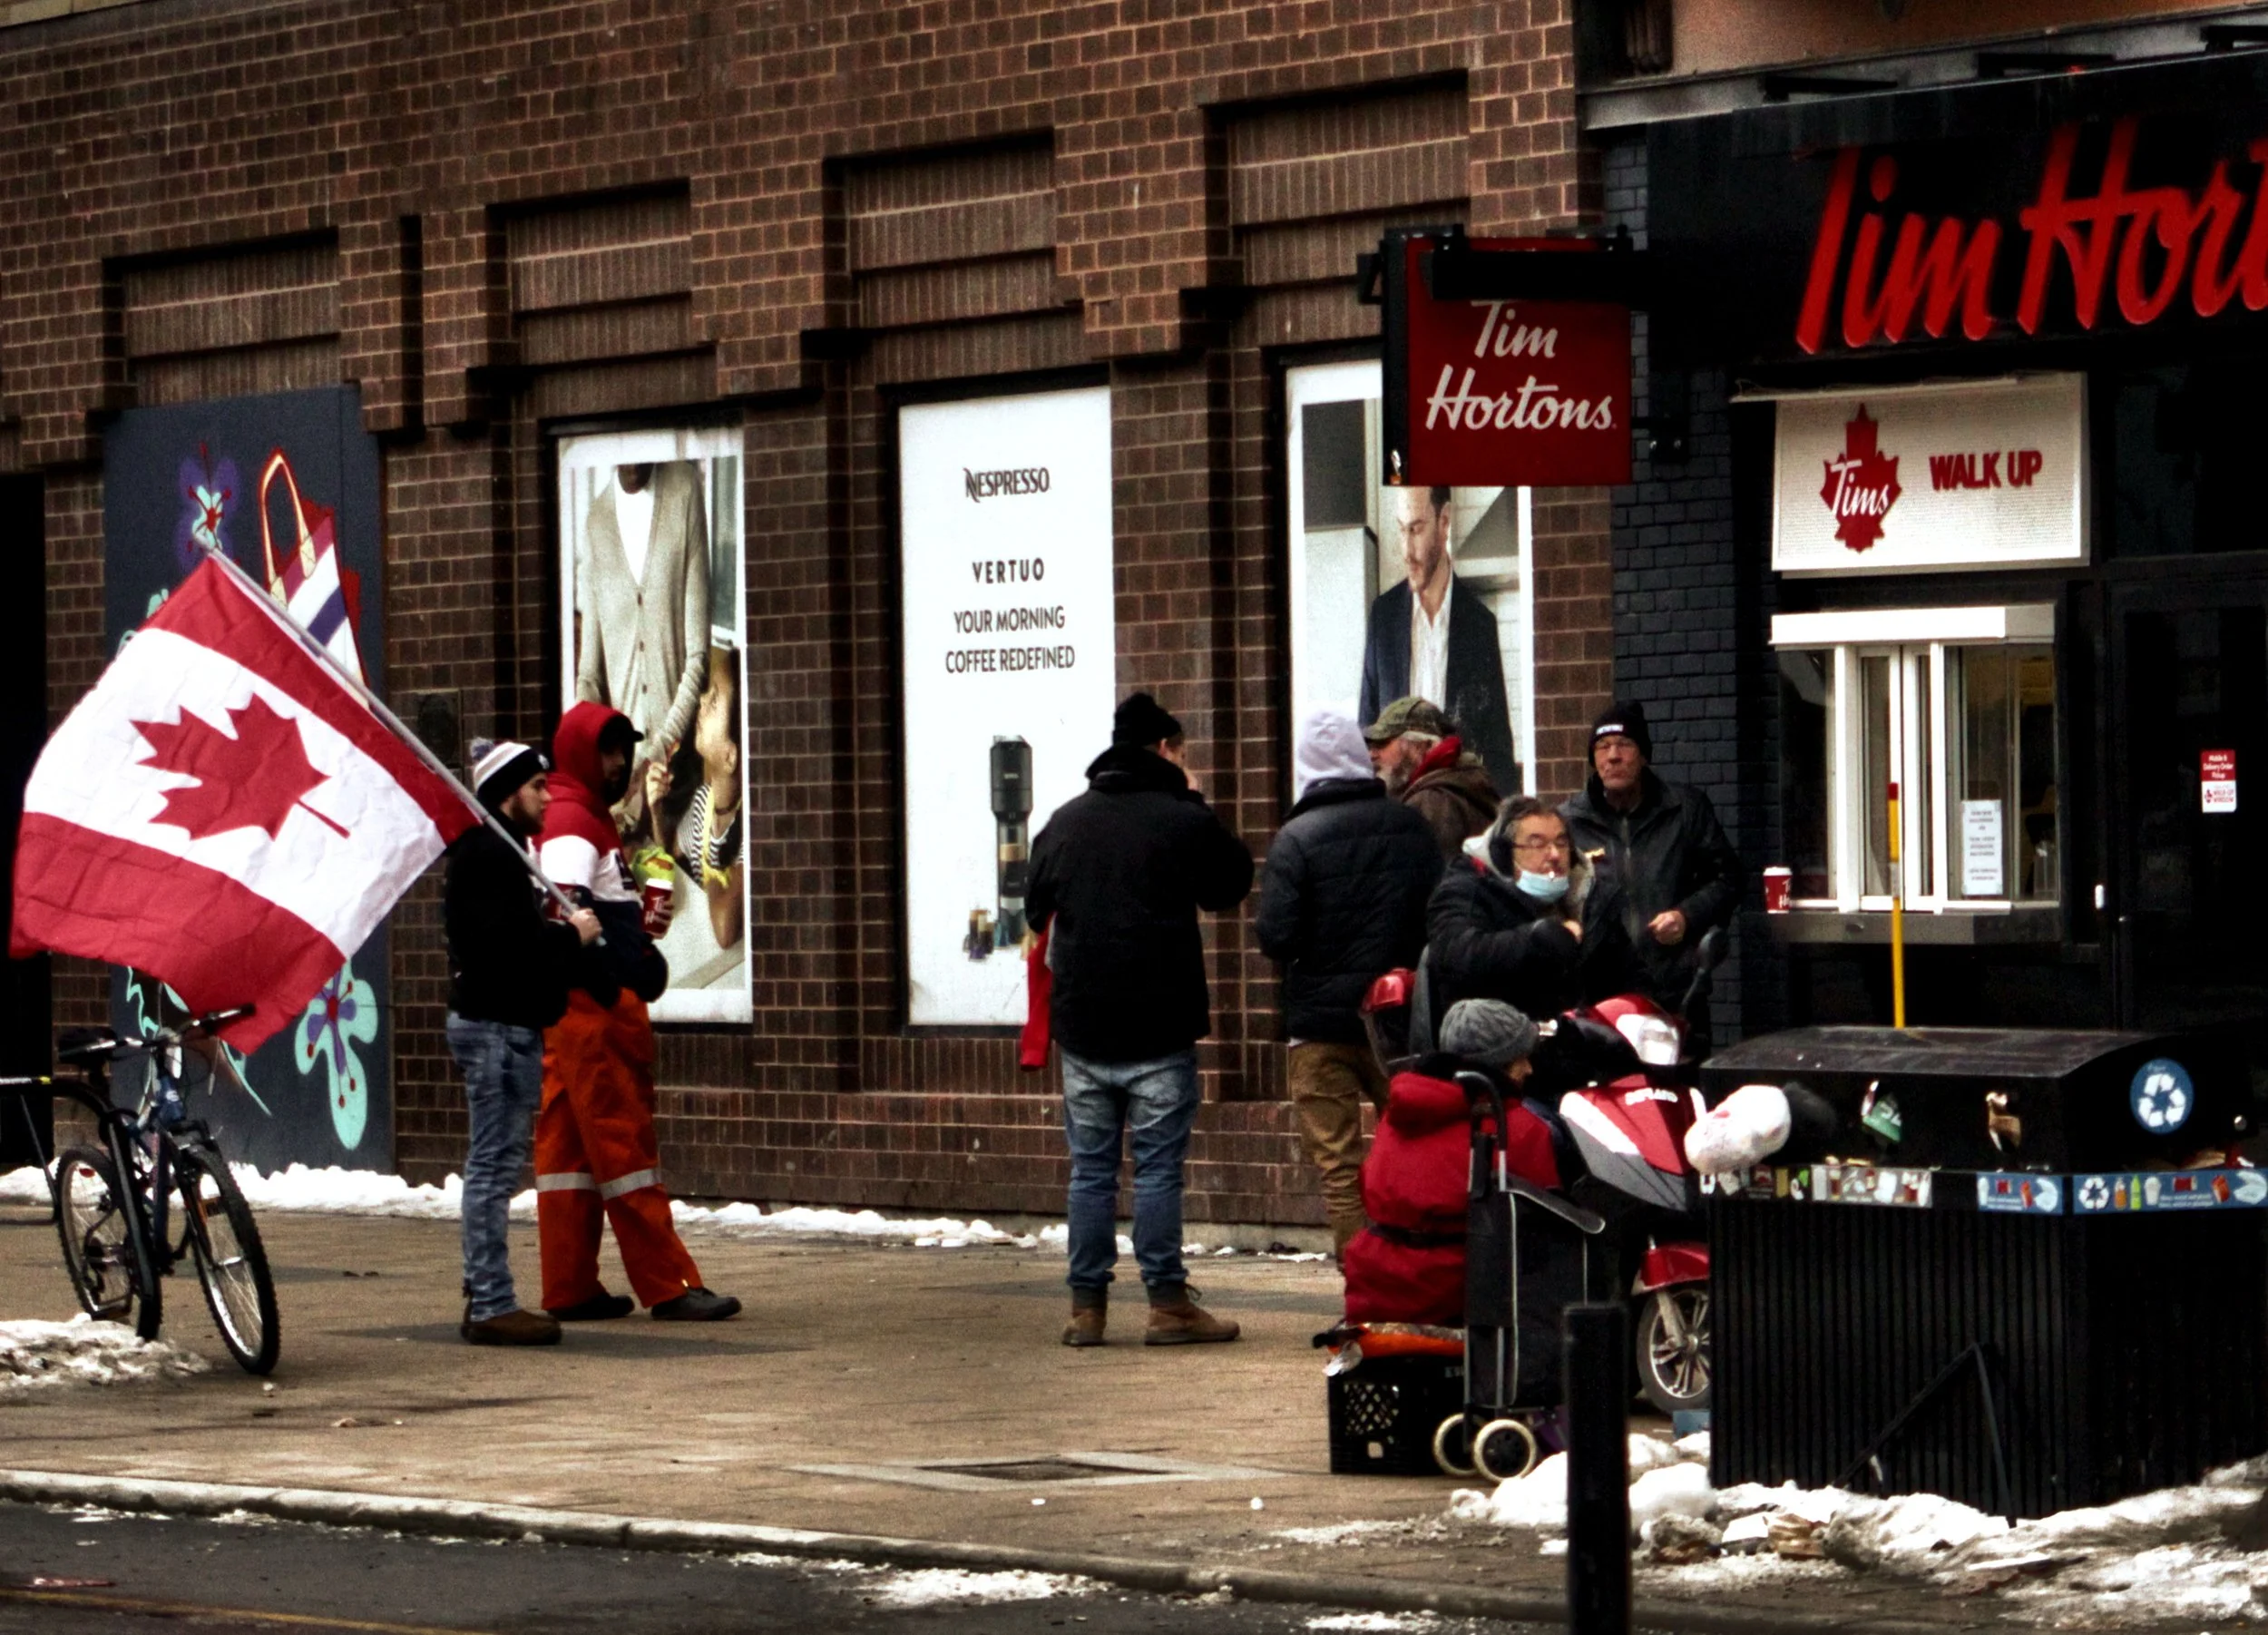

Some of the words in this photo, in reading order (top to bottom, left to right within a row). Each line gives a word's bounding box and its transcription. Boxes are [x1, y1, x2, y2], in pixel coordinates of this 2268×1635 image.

[1793, 143, 2002, 355] Tim
[1471, 299, 1559, 358] Tim
[1424, 364, 1613, 431] Hortons
[1831, 458, 1890, 516] Tims
[1930, 450, 2001, 491] WALK
[2008, 449, 2043, 488] UP
[972, 557, 1044, 584] VERTUO
[953, 610, 992, 633] YOUR
[996, 605, 1065, 632] MORNING
[945, 649, 996, 674] COFFEE
[1000, 645, 1075, 671] REDEFINED
